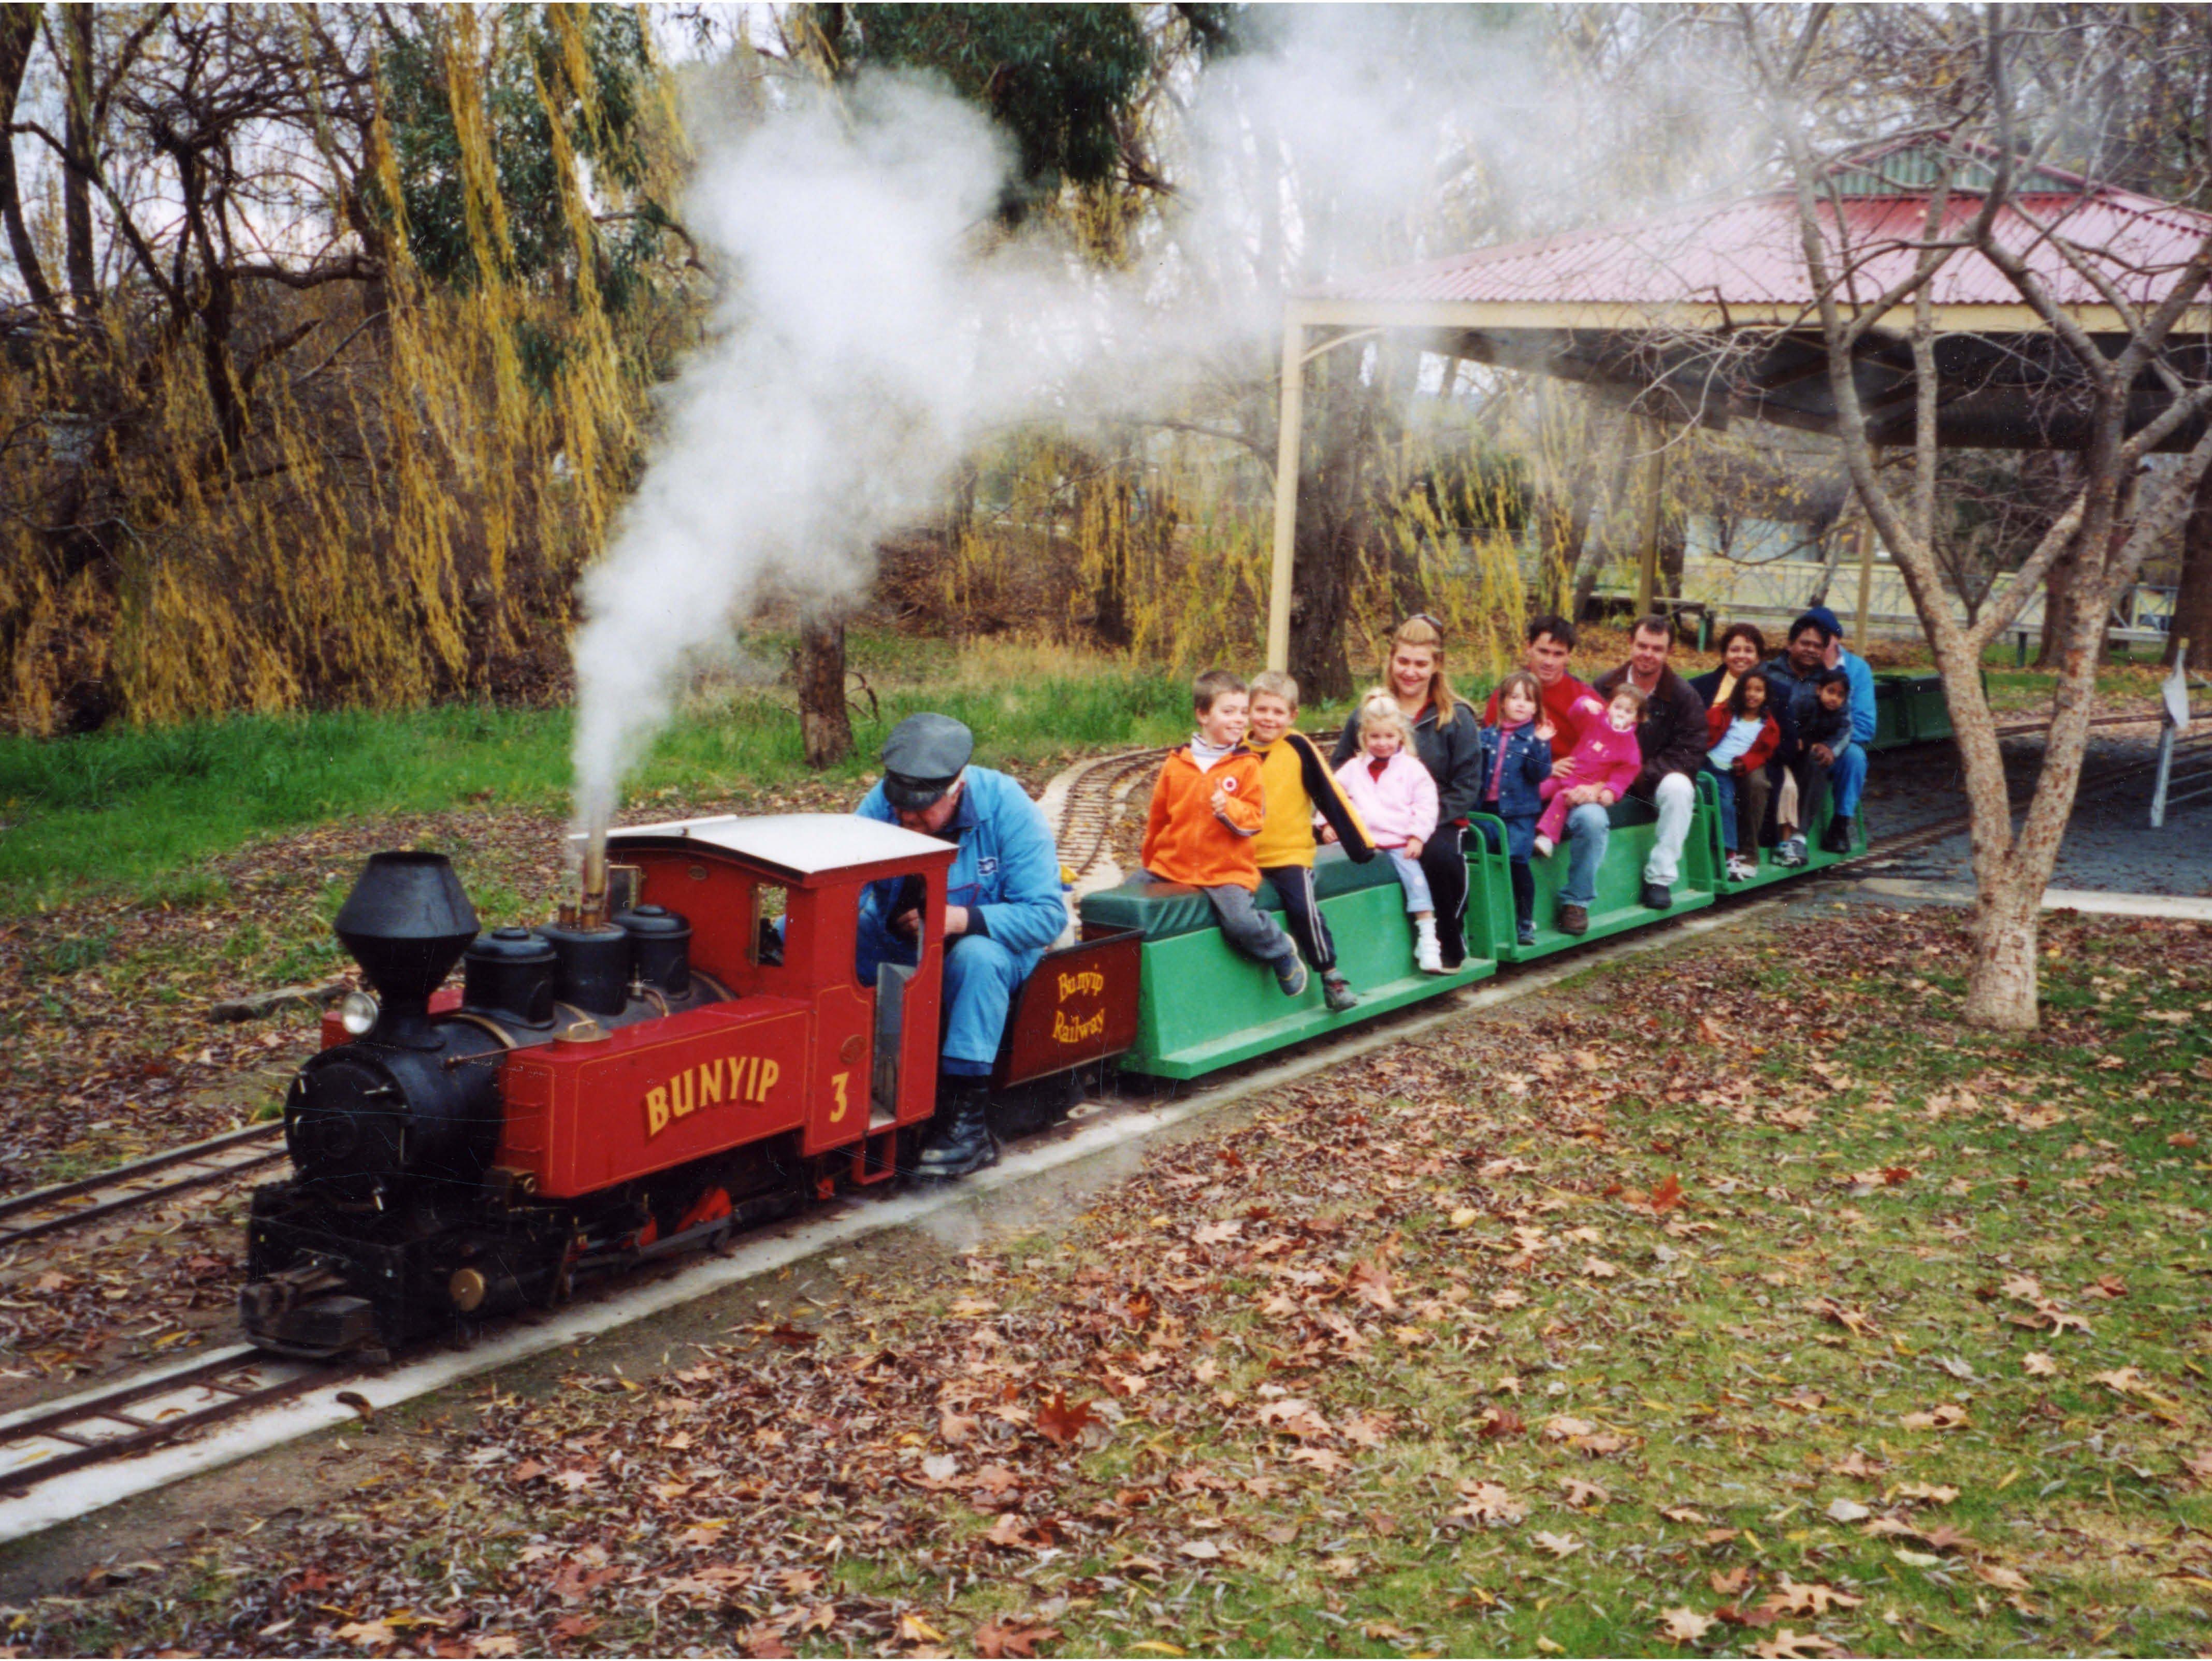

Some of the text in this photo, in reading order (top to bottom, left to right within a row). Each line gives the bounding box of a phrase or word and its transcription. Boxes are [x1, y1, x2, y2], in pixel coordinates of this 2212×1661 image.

[1058, 963, 1104, 1003] Bunyip
[1052, 1008, 1105, 1043] Railway
[645, 1057, 779, 1137] BUNYIP
[830, 1072, 849, 1122] 3
